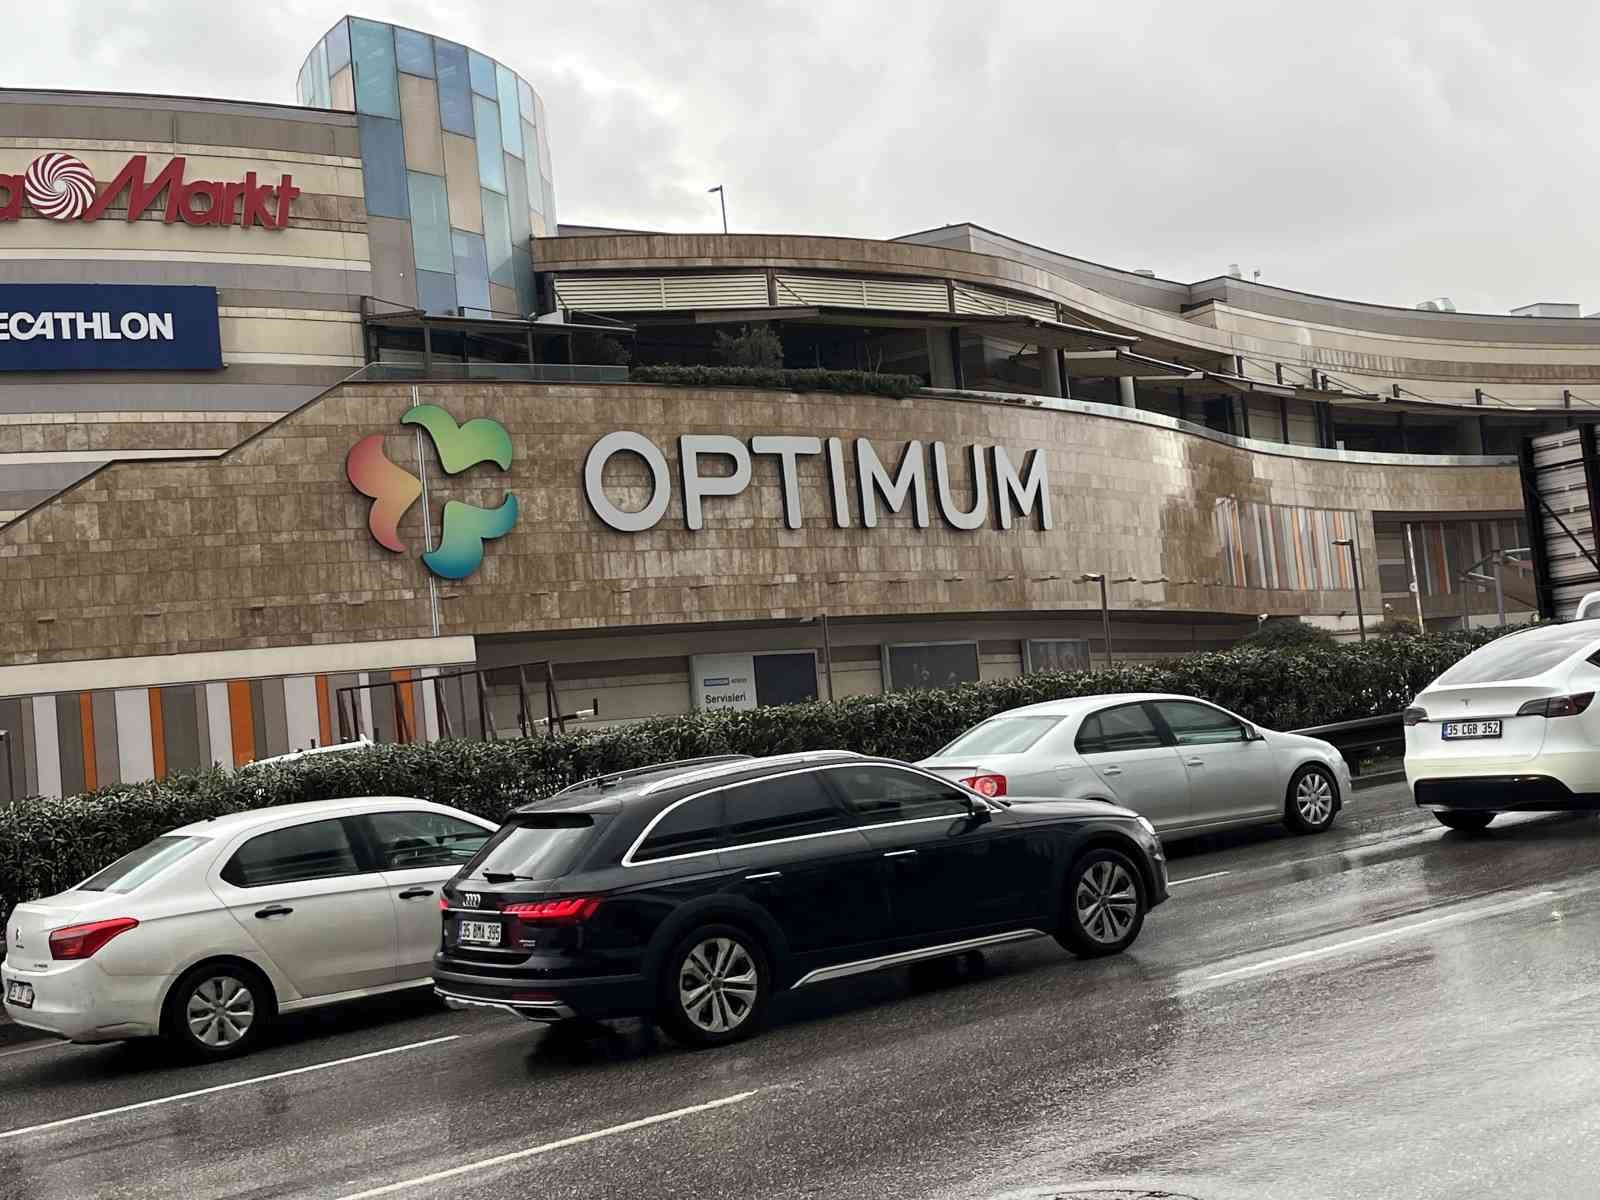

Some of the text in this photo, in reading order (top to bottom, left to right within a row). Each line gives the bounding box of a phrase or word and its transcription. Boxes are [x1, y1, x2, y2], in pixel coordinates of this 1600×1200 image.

[82, 154, 300, 231] Markt
[583, 430, 1053, 532] OPTIMUM
[1448, 722, 1499, 736] 35 CGB 352
